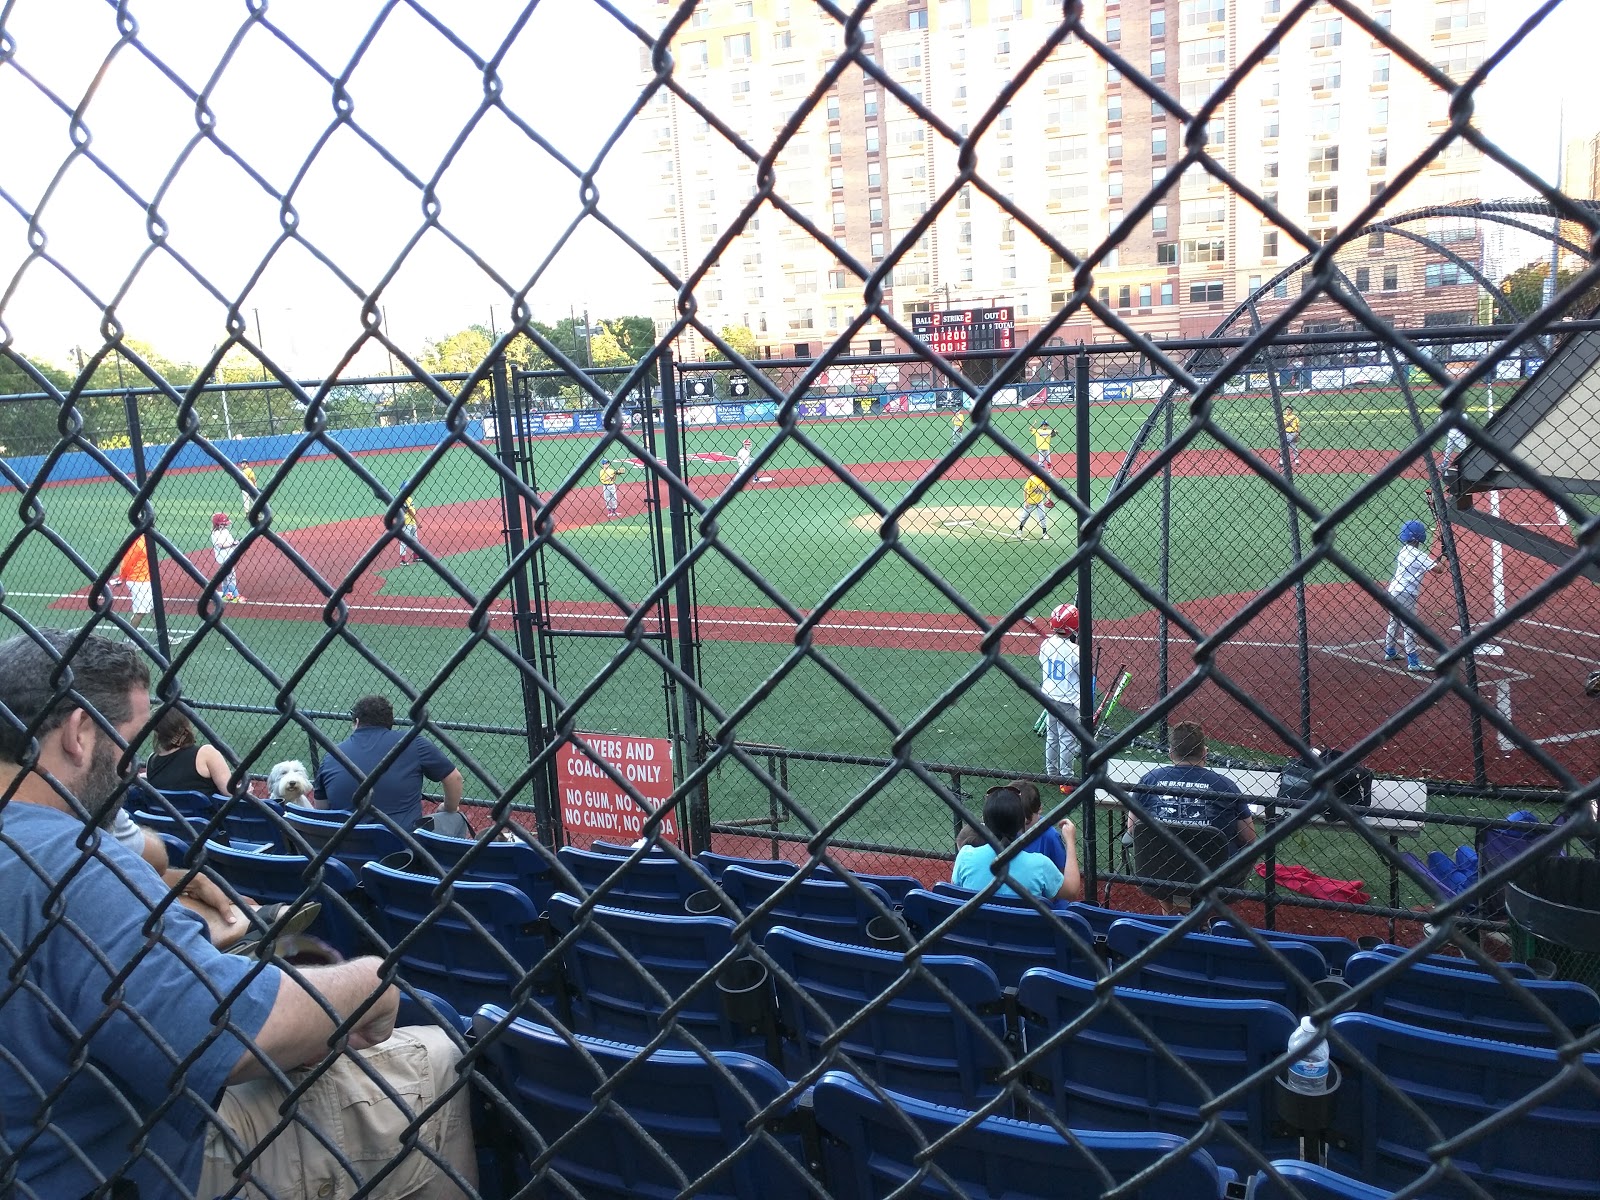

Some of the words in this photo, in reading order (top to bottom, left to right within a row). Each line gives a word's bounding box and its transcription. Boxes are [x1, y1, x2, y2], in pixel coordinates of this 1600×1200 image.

[933, 314, 940, 325] 2
[943, 314, 964, 322] STRIKE
[965, 312, 972, 322] 2
[1000, 310, 1007, 320] 0
[933, 332, 939, 341] 0
[947, 332, 952, 340] 2
[954, 331, 960, 340] 0
[960, 331, 966, 340] 0
[941, 343, 946, 352] 0
[947, 343, 953, 351] 0
[961, 342, 967, 350] 2
[1048, 658, 1065, 681] 10
[572, 739, 622, 759] PAYERS
[626, 742, 654, 760] AND
[627, 764, 661, 783] ONLY
[566, 788, 582, 806] NO
[585, 790, 613, 812] GUM,
[615, 794, 632, 811] NO
[565, 808, 581, 826] NO
[584, 810, 622, 832] CANDY,
[623, 815, 640, 832] NO
